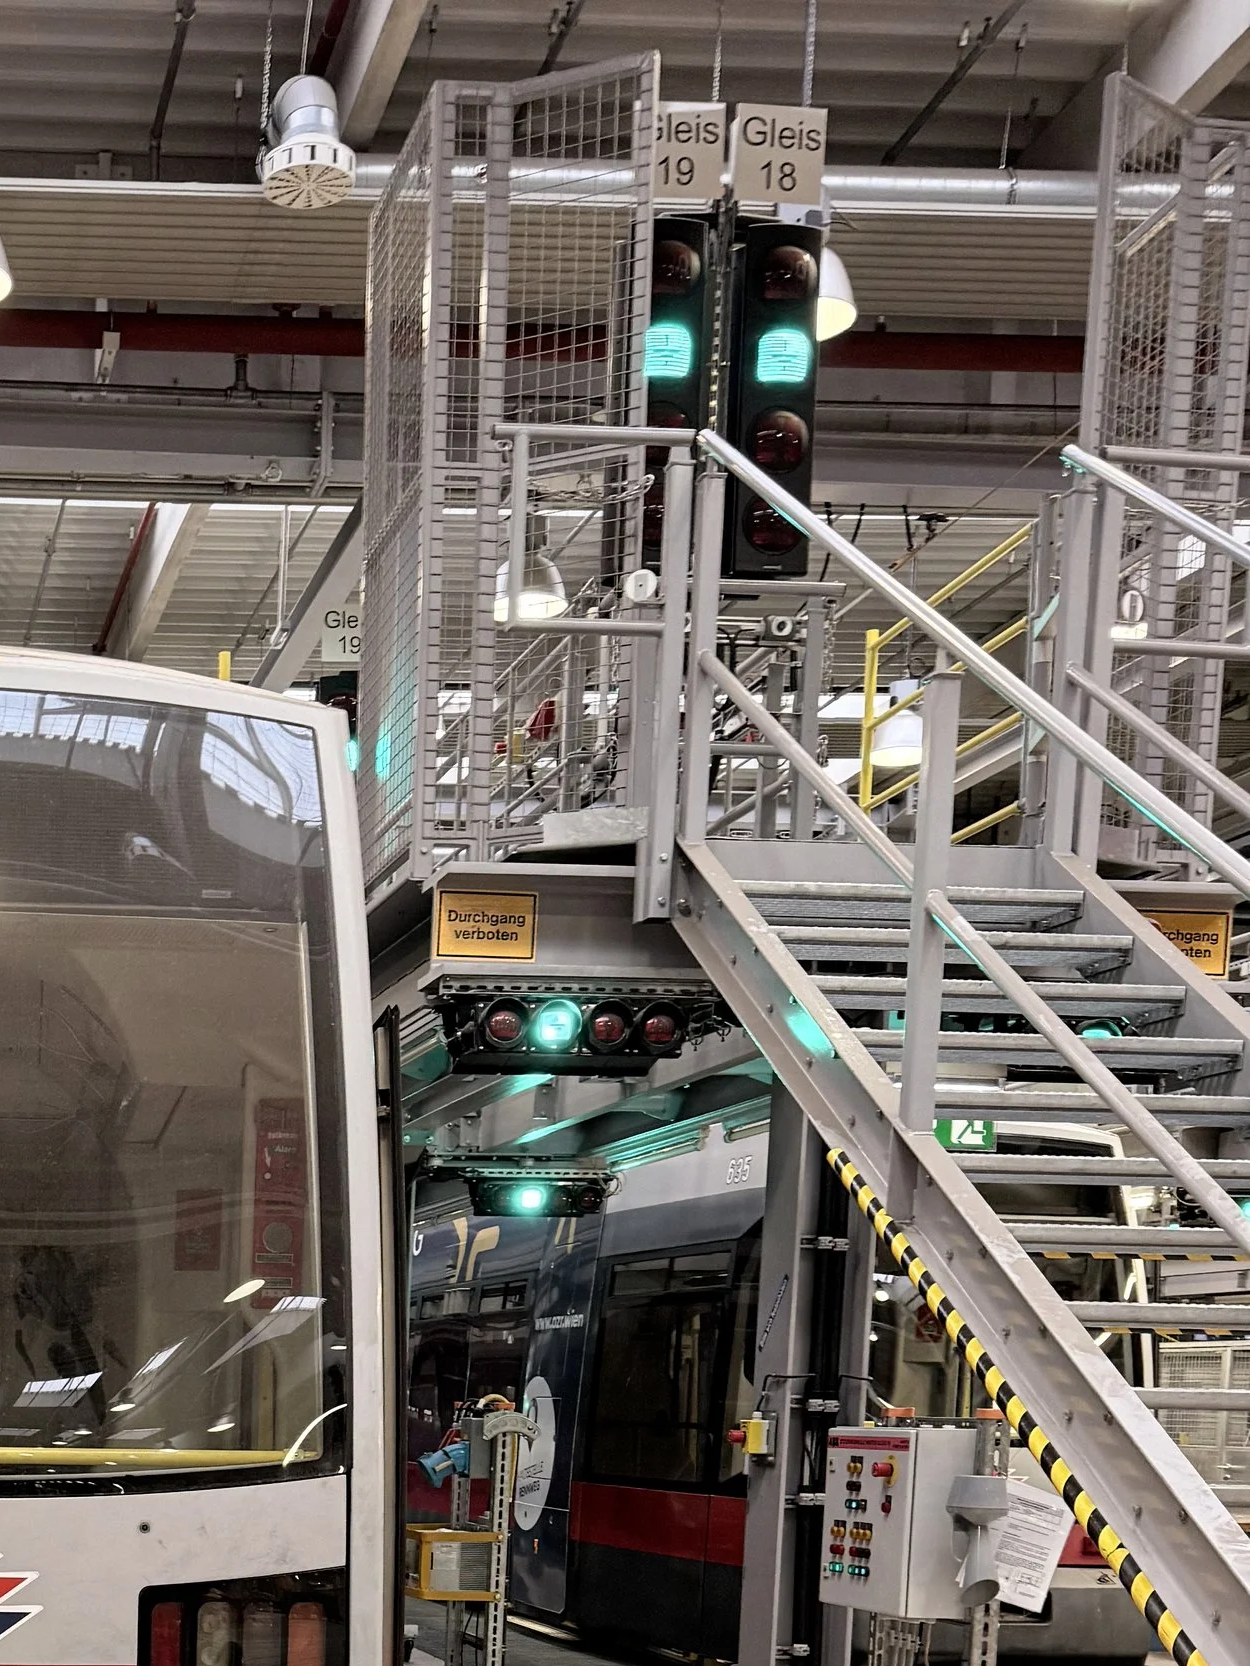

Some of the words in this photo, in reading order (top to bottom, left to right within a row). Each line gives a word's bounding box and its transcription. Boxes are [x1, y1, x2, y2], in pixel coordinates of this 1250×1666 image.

[743, 116, 822, 151] Gleis
[658, 156, 695, 186] 19
[760, 160, 797, 191] 18
[325, 610, 359, 629] Gle
[338, 635, 361, 654] 19
[447, 909, 526, 927] Durchgang
[454, 927, 518, 941] verboten
[1163, 929, 1219, 945] rchgang
[1181, 946, 1212, 958] oten
[726, 1155, 753, 1185] 635
